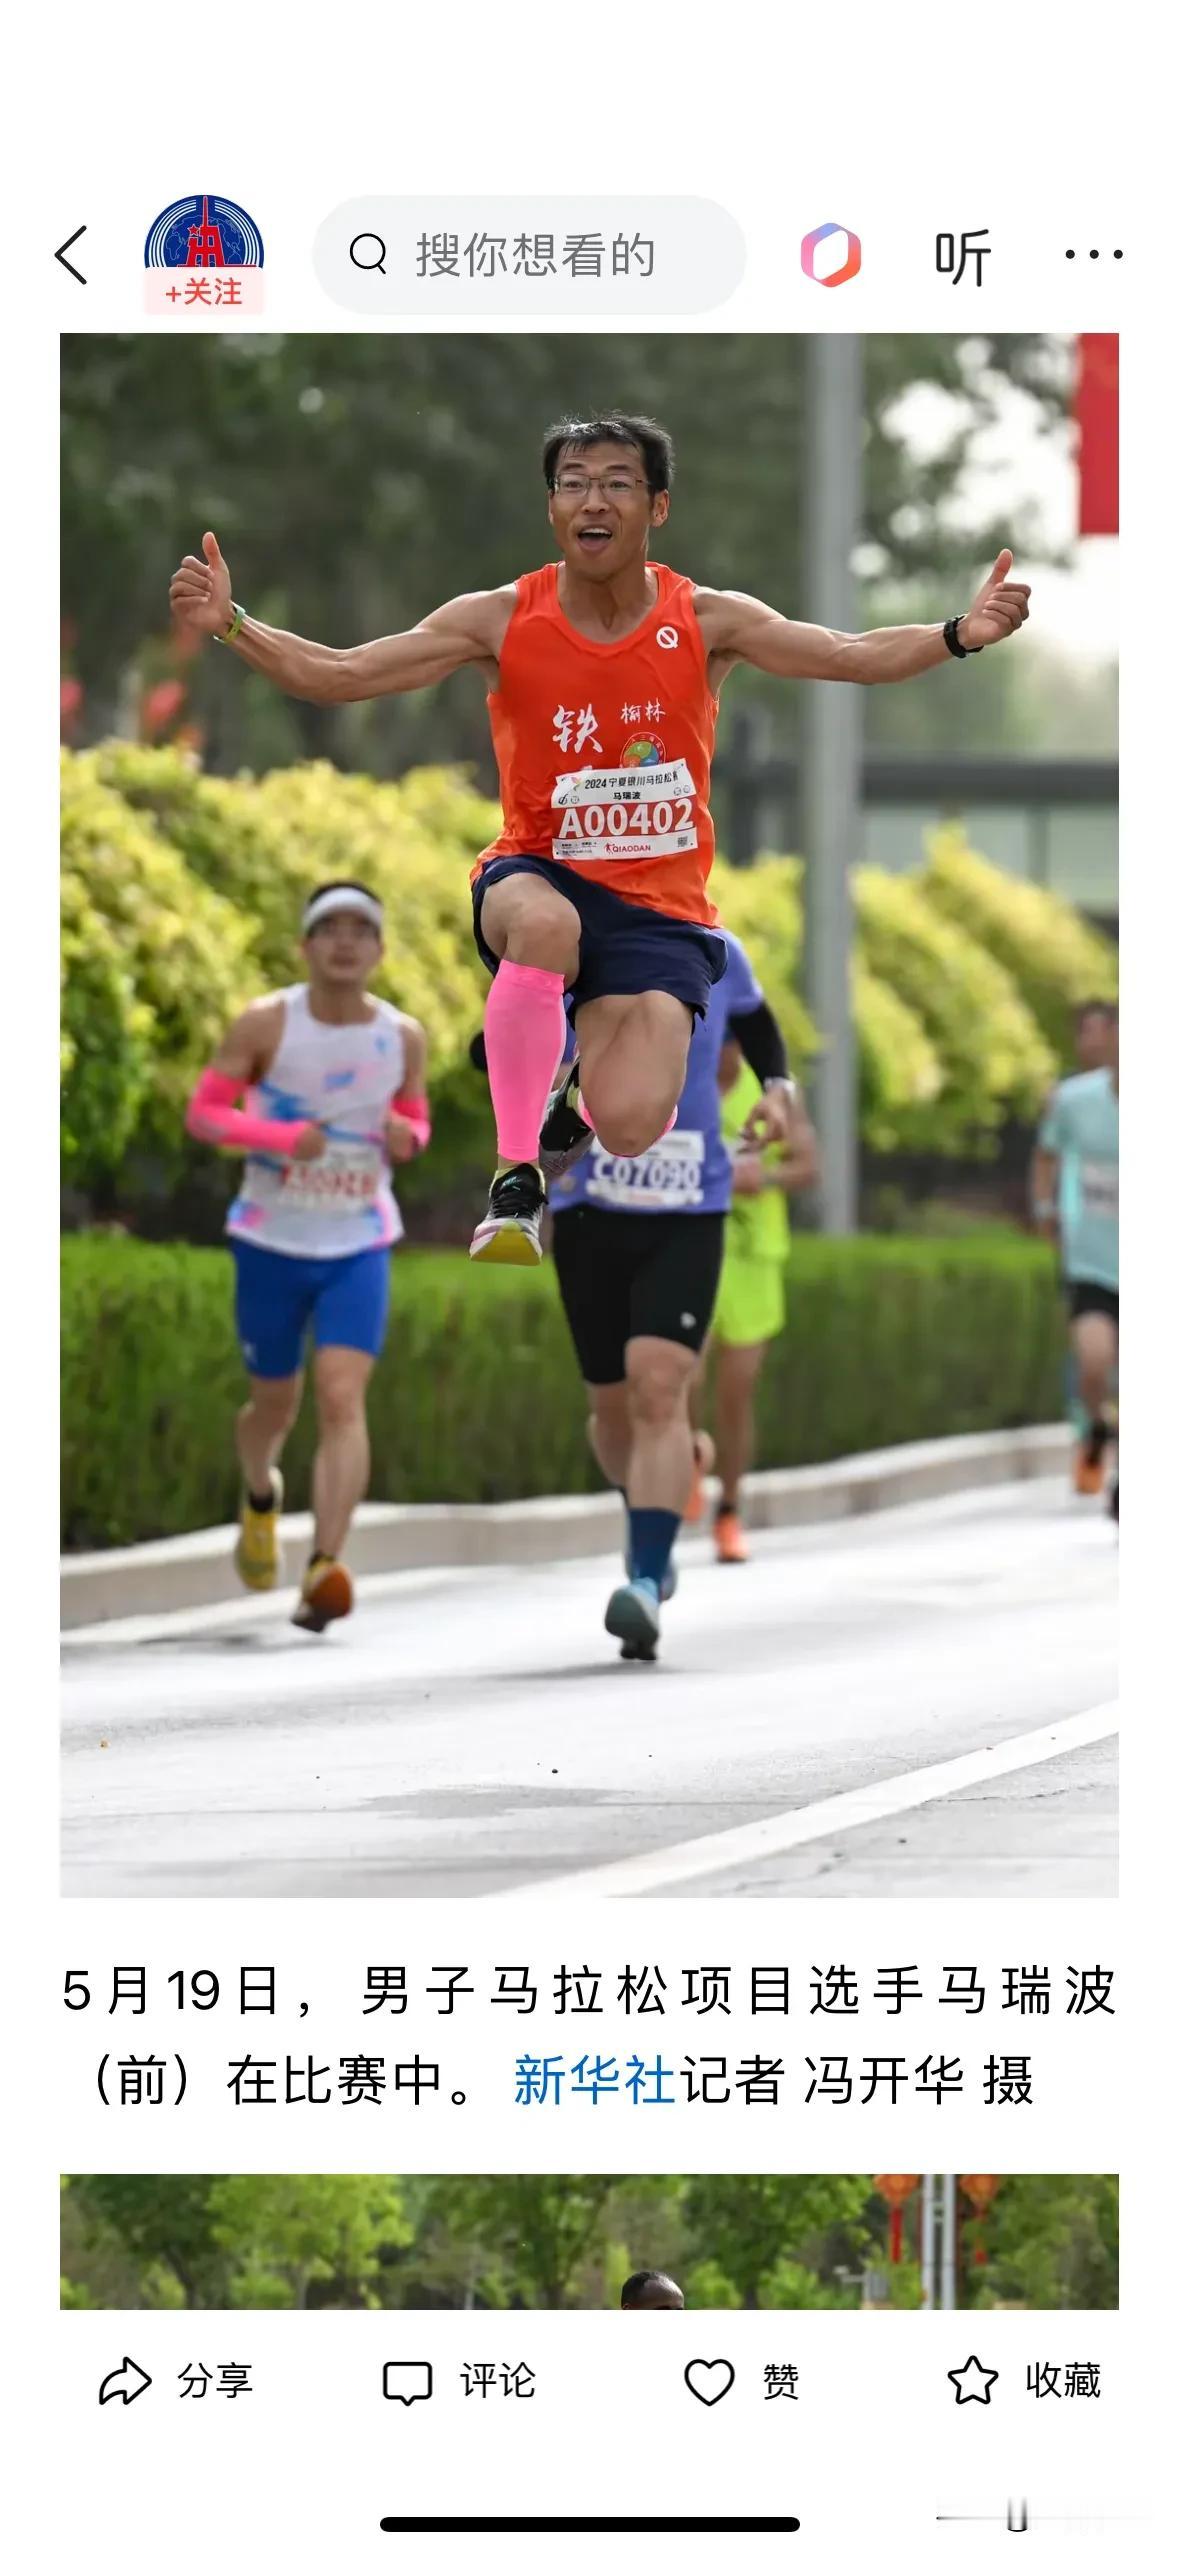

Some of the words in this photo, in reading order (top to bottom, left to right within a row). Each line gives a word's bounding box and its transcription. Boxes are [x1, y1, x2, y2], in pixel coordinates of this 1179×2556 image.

[415, 232, 655, 278] 搜你想看的
[935, 228, 992, 288] 听
[165, 277, 243, 306] +关注
[552, 702, 604, 754] 铁
[620, 697, 666, 725] 榆林
[613, 791, 641, 801] 马瑞波
[558, 797, 694, 839] A00402
[612, 844, 651, 854] QIAODAN
[594, 1157, 700, 1190] C07090
[804, 2053, 964, 2105] 冯开华
[982, 2053, 1034, 2105] 摄
[176, 2361, 254, 2399] 分享
[459, 2361, 537, 2399] 评论
[763, 2363, 800, 2401] 赞
[1025, 2361, 1102, 2399] 收藏
